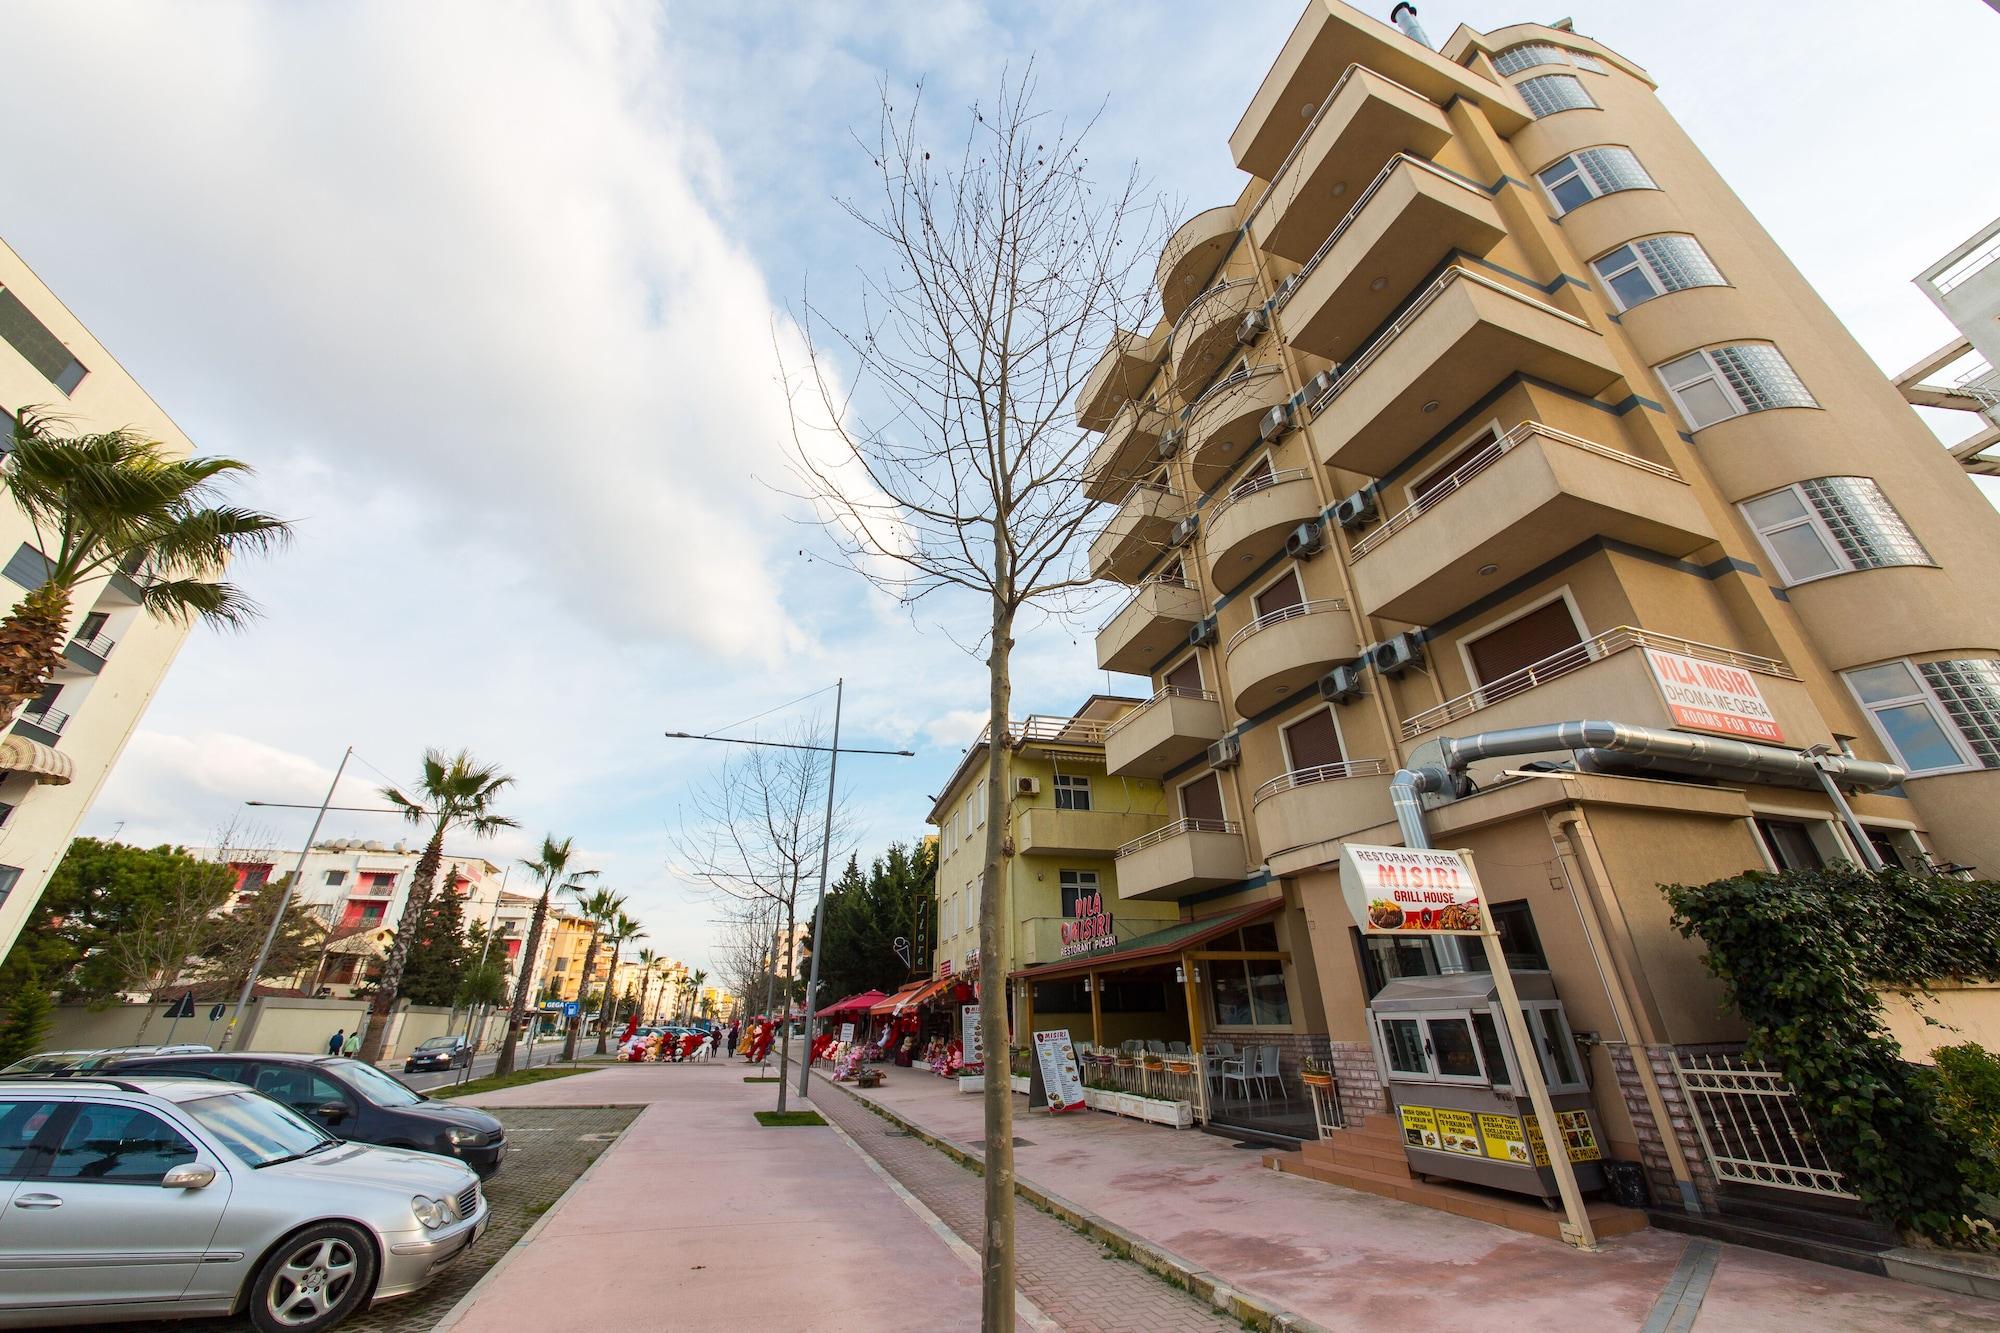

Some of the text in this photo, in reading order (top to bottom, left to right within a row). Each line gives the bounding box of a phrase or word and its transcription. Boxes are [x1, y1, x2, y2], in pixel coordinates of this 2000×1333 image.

[1652, 654, 1757, 698] VILA MISIRI
[1665, 684, 1770, 717] DHOMA ME QERA
[1681, 708, 1777, 737] ROOMS FOR RENT
[1356, 850, 1460, 867] RESTORANT PICERI
[1377, 864, 1461, 889] MISIRI
[1074, 892, 1102, 919] VILA
[1394, 890, 1456, 904] GRILL HOUSE
[917, 900, 927, 966] flore
[1070, 911, 1112, 943] MISIRI
[1060, 935, 1117, 957] RESTORANT PICERI
[546, 1001, 564, 1009] GEGA
